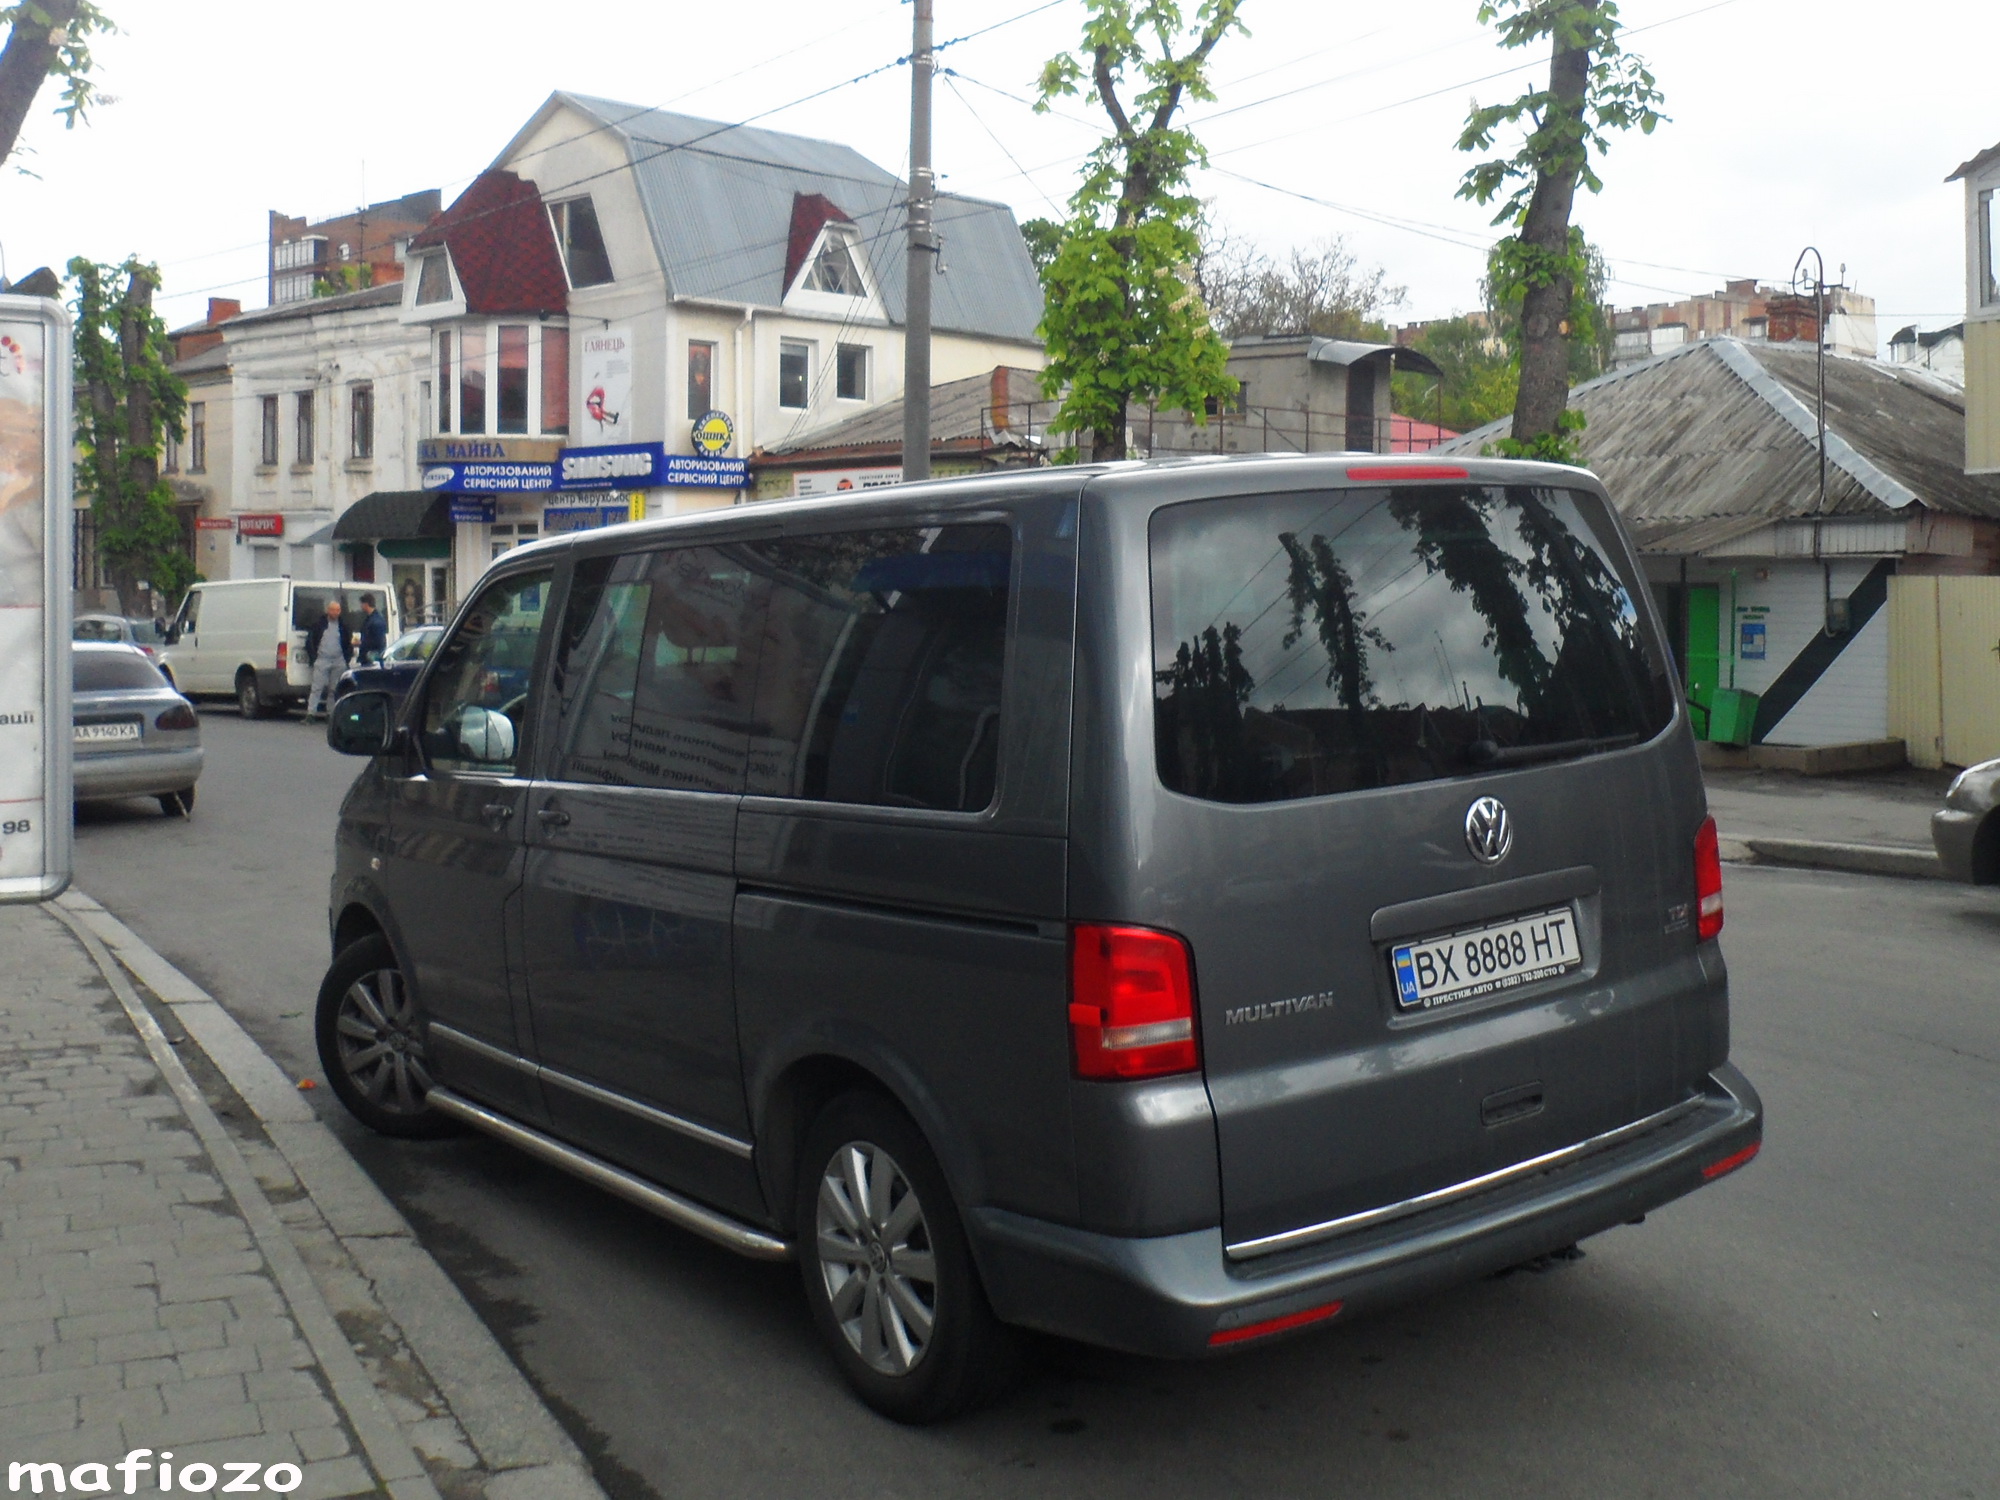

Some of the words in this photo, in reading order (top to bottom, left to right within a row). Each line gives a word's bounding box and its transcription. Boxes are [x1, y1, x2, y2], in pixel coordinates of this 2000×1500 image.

[464, 465, 552, 476] АВТОРИЗОВАНИЙ
[562, 452, 652, 480] SAMSUNG
[668, 459, 745, 472] АВТОРИЗОВАНИЙ
[464, 478, 519, 489] СЕРВІСНИЙ
[521, 479, 552, 489] ЦЕНТР
[668, 473, 717, 484] СЕРВІСНИЙ
[720, 474, 745, 486] ЦЕНТР
[548, 493, 576, 508] центр
[120, 724, 136, 736] KA
[2, 819, 31, 835] 98
[1415, 944, 1460, 990] BX
[1464, 930, 1527, 977] 8888
[1530, 919, 1566, 962] HT
[1401, 981, 1416, 995] UA
[1225, 991, 1333, 1026] MULTIVAN
